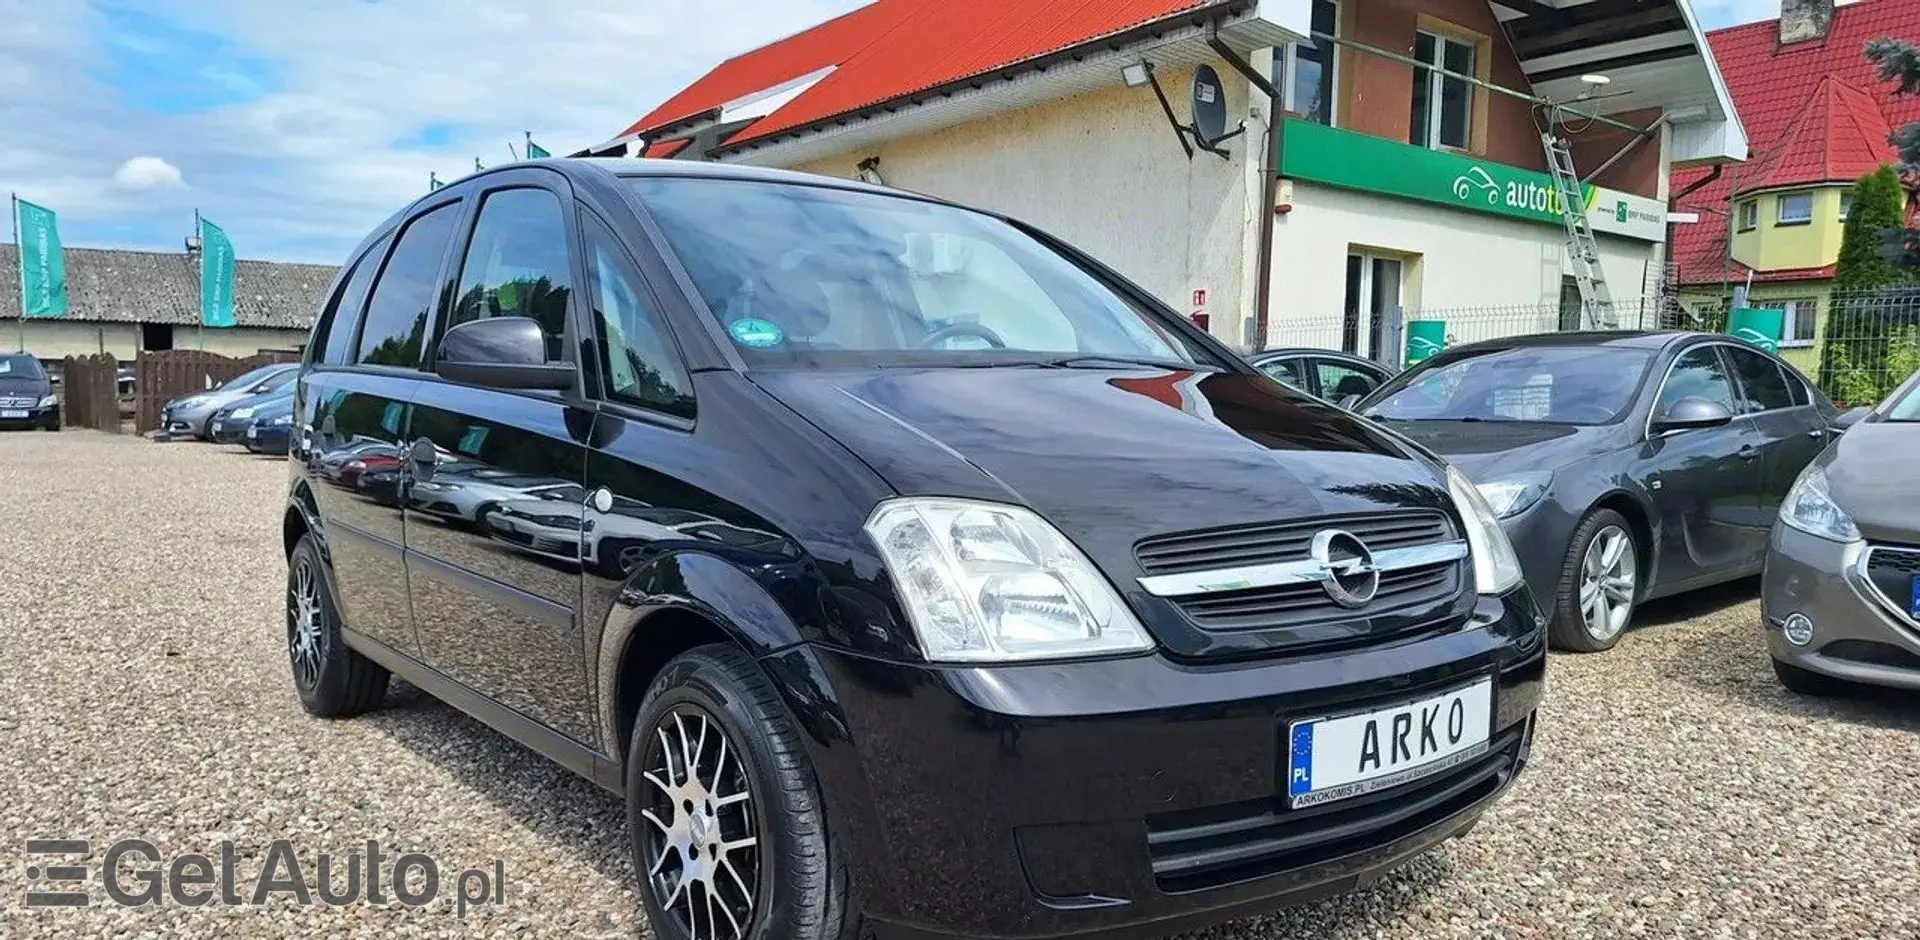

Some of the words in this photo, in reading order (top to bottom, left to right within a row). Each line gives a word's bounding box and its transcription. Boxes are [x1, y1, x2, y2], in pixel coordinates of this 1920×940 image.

[1358, 697, 1463, 774] ARKO
[1293, 767, 1309, 783] PL
[1297, 783, 1364, 806] ARKOKOMIS.PL
